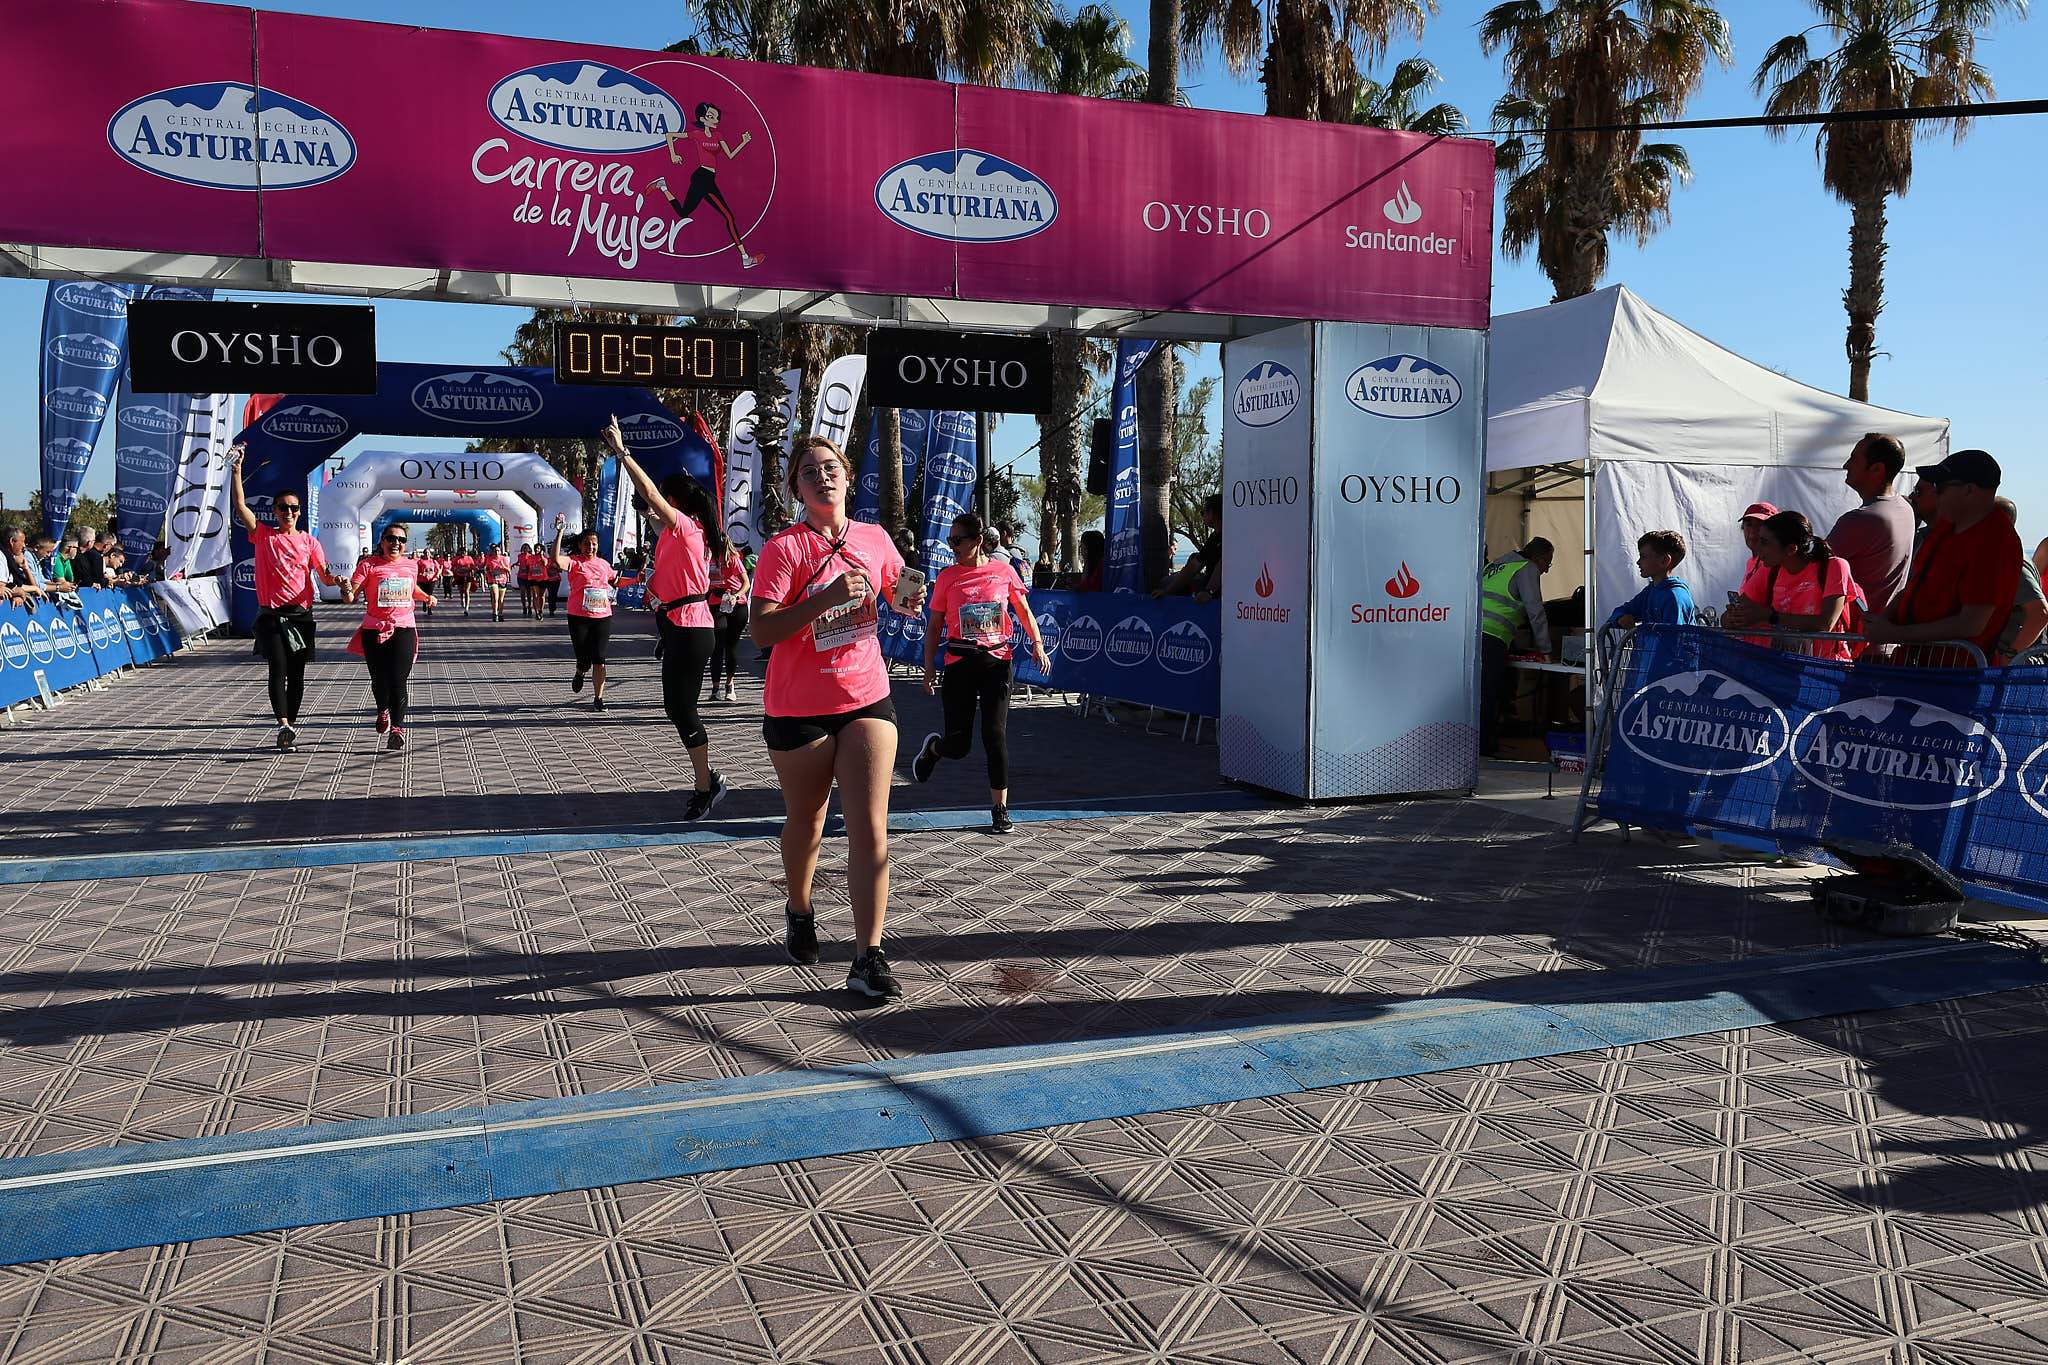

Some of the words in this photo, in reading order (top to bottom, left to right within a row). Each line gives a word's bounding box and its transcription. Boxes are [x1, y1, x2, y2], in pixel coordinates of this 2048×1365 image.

[504, 87, 669, 135] ASTURIANA
[535, 88, 596, 103] CENTRAL
[603, 94, 664, 109] LECHERA
[166, 115, 244, 130] CENTRAL
[128, 115, 338, 167] ASTURIANA
[472, 138, 634, 197] Carrera
[918, 177, 976, 191] CENTRAL
[981, 183, 1039, 196] LECHERA
[890, 177, 1044, 222] ASTURIANA
[513, 190, 543, 224] de
[550, 192, 571, 227] la
[568, 194, 694, 269] Mujer
[1142, 201, 1271, 239] OYSHO
[1345, 225, 1457, 255] Santander
[171, 330, 343, 368] OYSHO
[569, 333, 744, 378] 00:59:01
[898, 355, 1028, 389] OYSHO
[422, 386, 534, 412] ASTURIANA
[1237, 388, 1295, 415] ASTURIANA
[1353, 377, 1453, 405] ASTURIANA
[123, 412, 179, 431] ASTURIANA
[267, 419, 342, 434] ASTURIANA
[622, 428, 679, 440] STURIANA
[400, 460, 504, 481] OYSHO
[336, 480, 369, 489] OYSHO
[533, 481, 564, 490] OYSHO
[1232, 476, 1299, 508] OYSHO
[1340, 474, 1461, 505] OYSHO
[323, 521, 354, 530] OYSHO
[1236, 601, 1291, 625] Santander
[1351, 603, 1450, 624] Santander
[1064, 631, 1098, 650] ASTURIANA
[1108, 633, 1149, 655] ASTURIANA
[1159, 638, 1205, 663] ASTURIANA
[1659, 700, 1711, 715] CENTRAL
[1715, 708, 1772, 724] LECHERA
[1627, 700, 1771, 756] ASTURIANA
[1801, 723, 1985, 788] ASTURIANA
[1912, 736, 1984, 753] LECHERA
